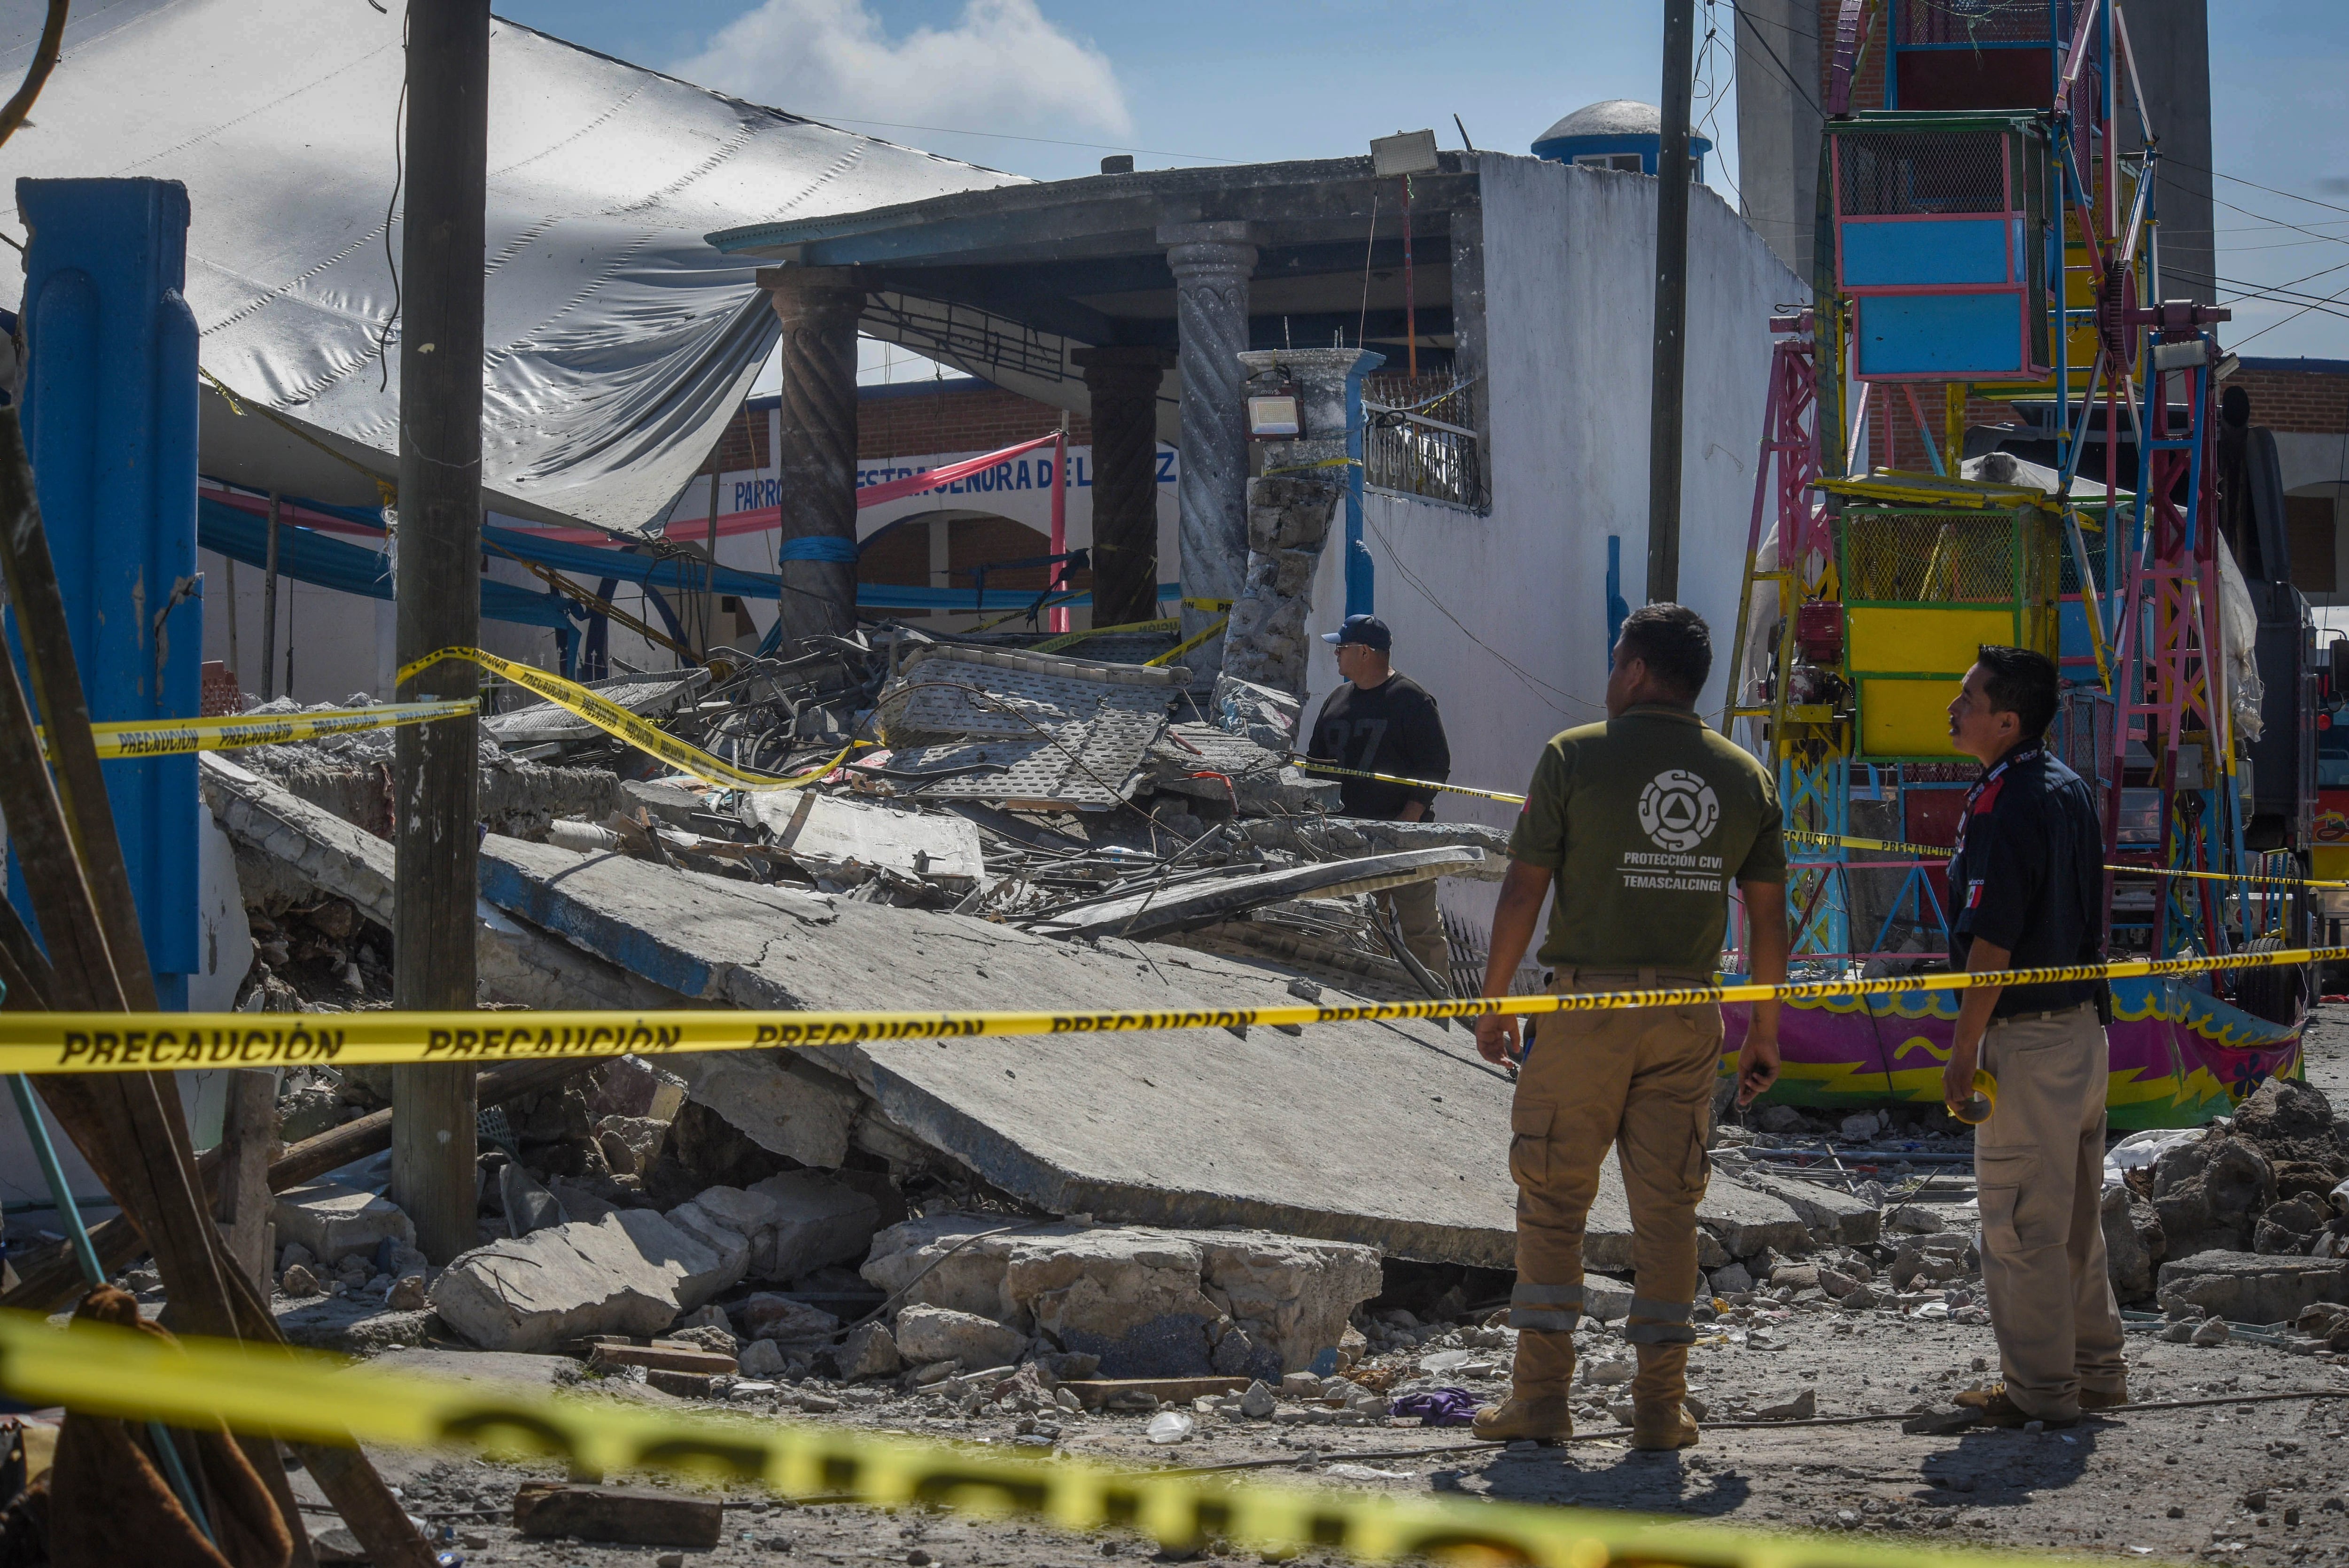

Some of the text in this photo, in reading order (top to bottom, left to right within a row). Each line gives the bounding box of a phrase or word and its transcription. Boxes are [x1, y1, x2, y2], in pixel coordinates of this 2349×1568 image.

[117, 724, 199, 753] PRECAUCIÓN
[218, 720, 293, 747] PRECAUCIÓN
[1624, 852, 1722, 869] PROTECCIÓN CIVI
[60, 1021, 344, 1065] PRECAUCIÓN
[422, 1018, 681, 1058] PRECAUCIÓN
